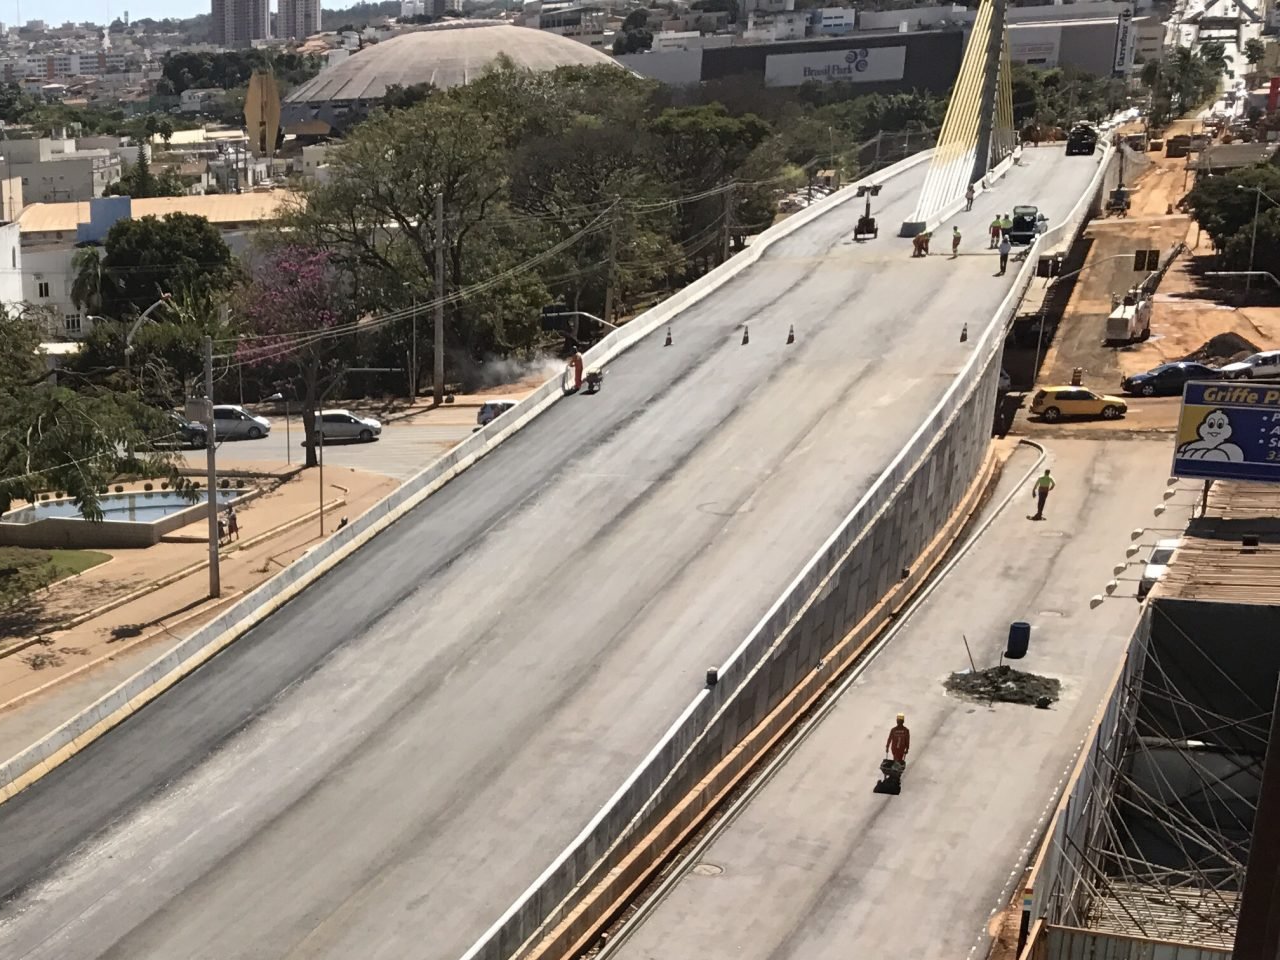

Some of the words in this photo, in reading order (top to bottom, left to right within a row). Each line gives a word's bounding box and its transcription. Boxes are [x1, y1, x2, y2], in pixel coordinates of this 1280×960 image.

[1117, 25, 1128, 66] Carrefour
[803, 65, 831, 77] Brasil
[832, 64, 853, 75] Park
[1203, 387, 1259, 404] Griffe
